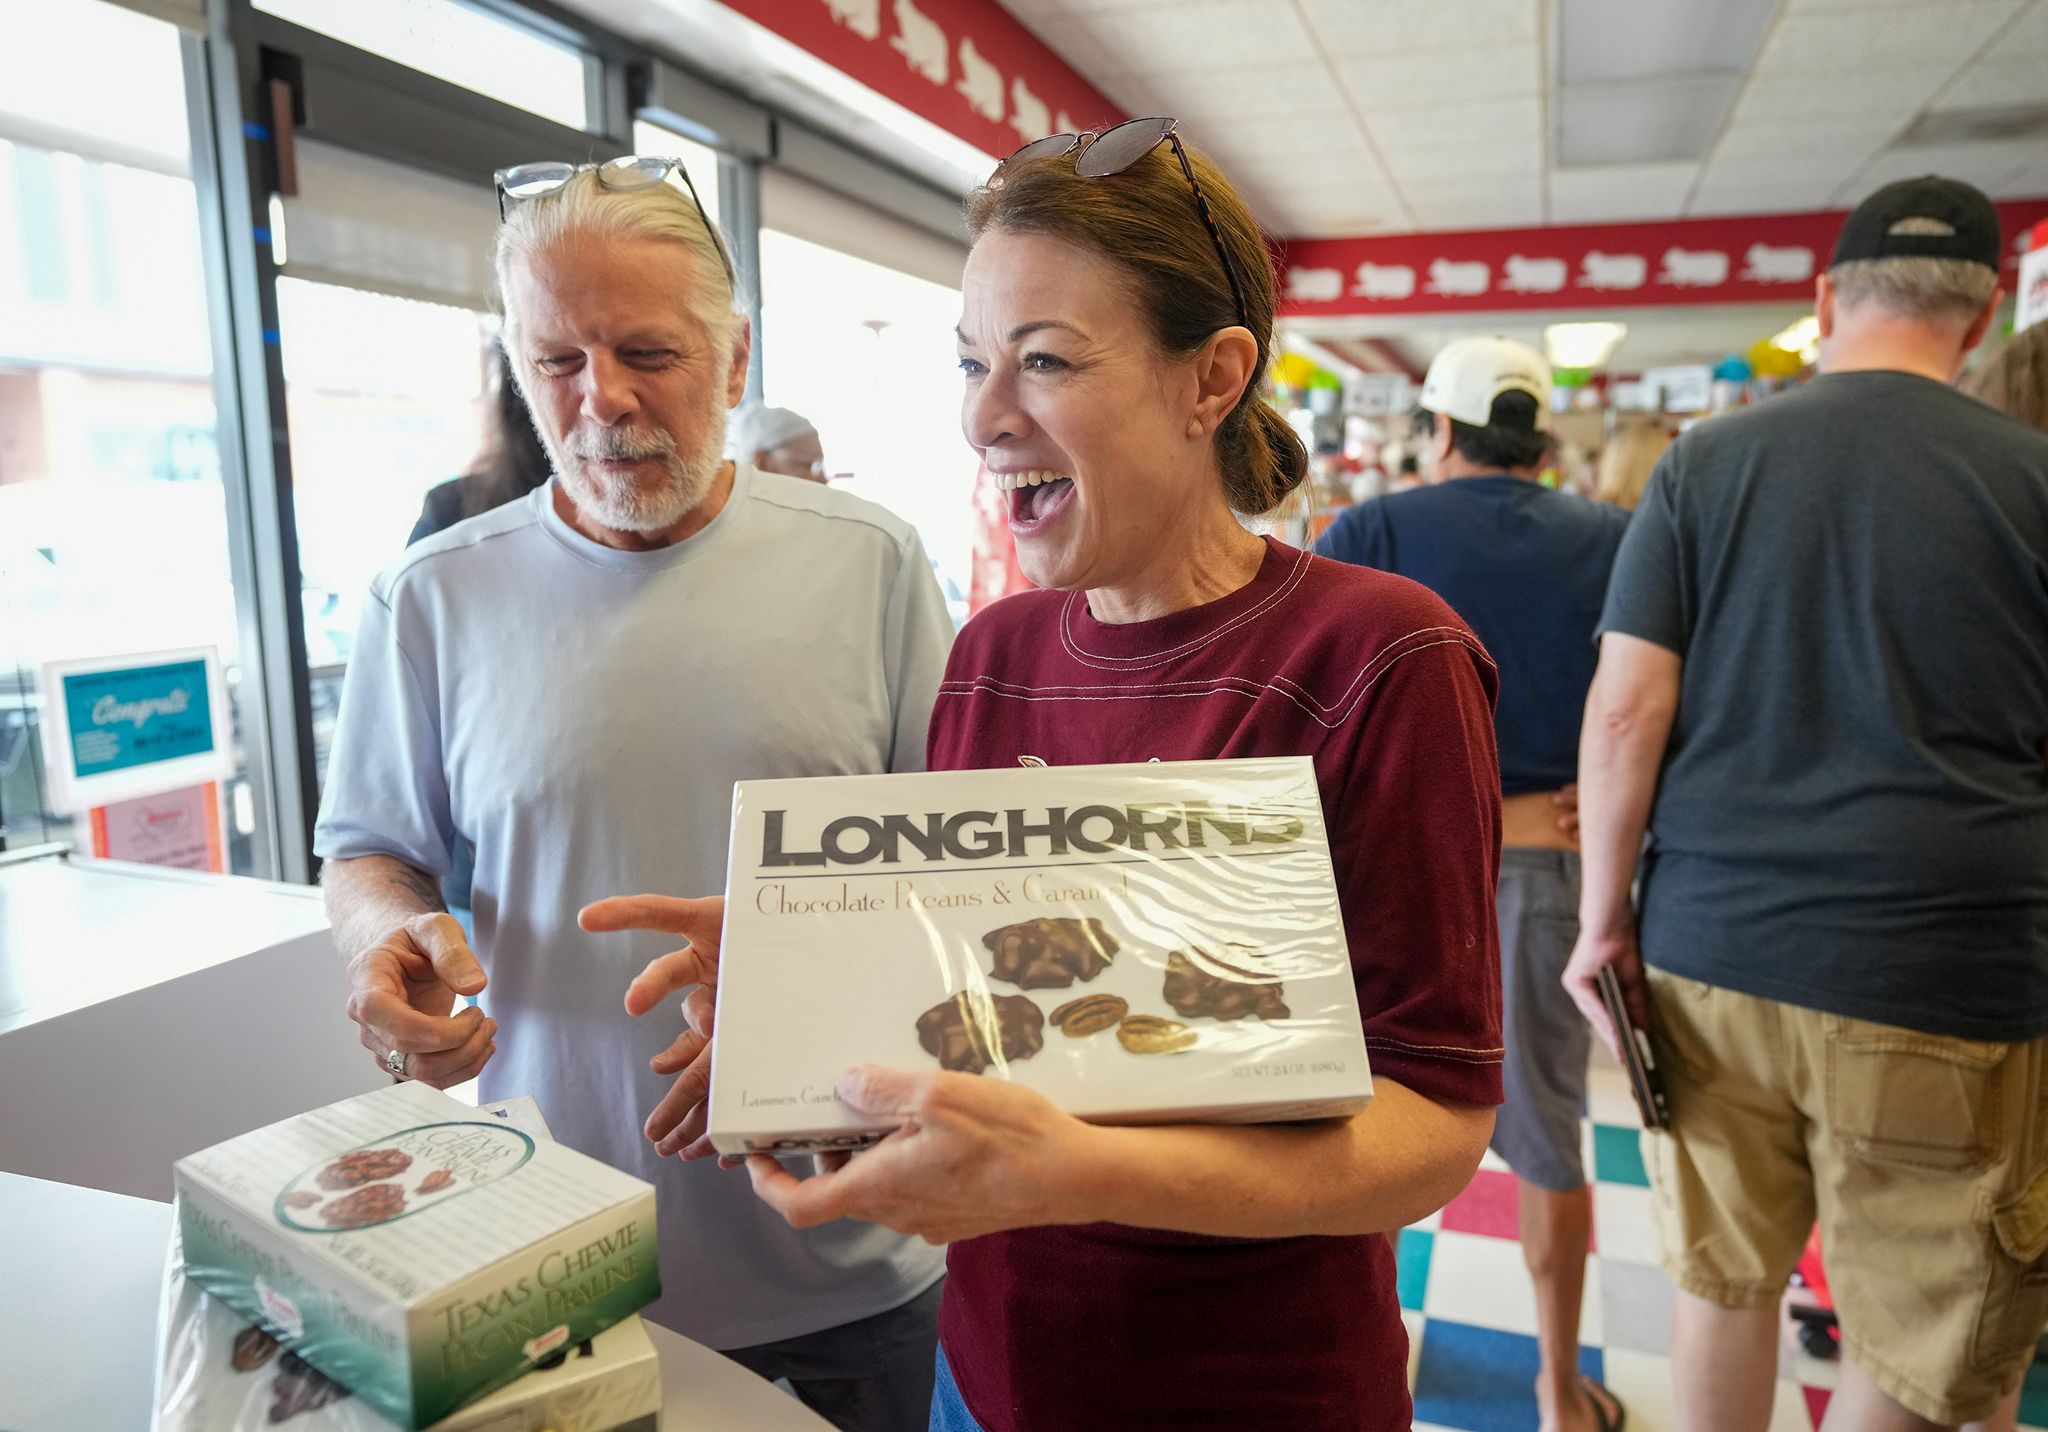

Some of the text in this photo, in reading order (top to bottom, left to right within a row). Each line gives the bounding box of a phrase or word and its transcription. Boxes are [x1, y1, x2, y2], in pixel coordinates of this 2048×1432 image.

[757, 799, 1304, 869] LONGHORNS
[756, 882, 886, 915] Chocolate
[993, 881, 1011, 905] &
[742, 1085, 842, 1107] Lammes Cand
[431, 1219, 641, 1341] TEXAS CHEWIE
[440, 1304, 537, 1378] PECAN
[543, 1253, 642, 1323] PRALINE
